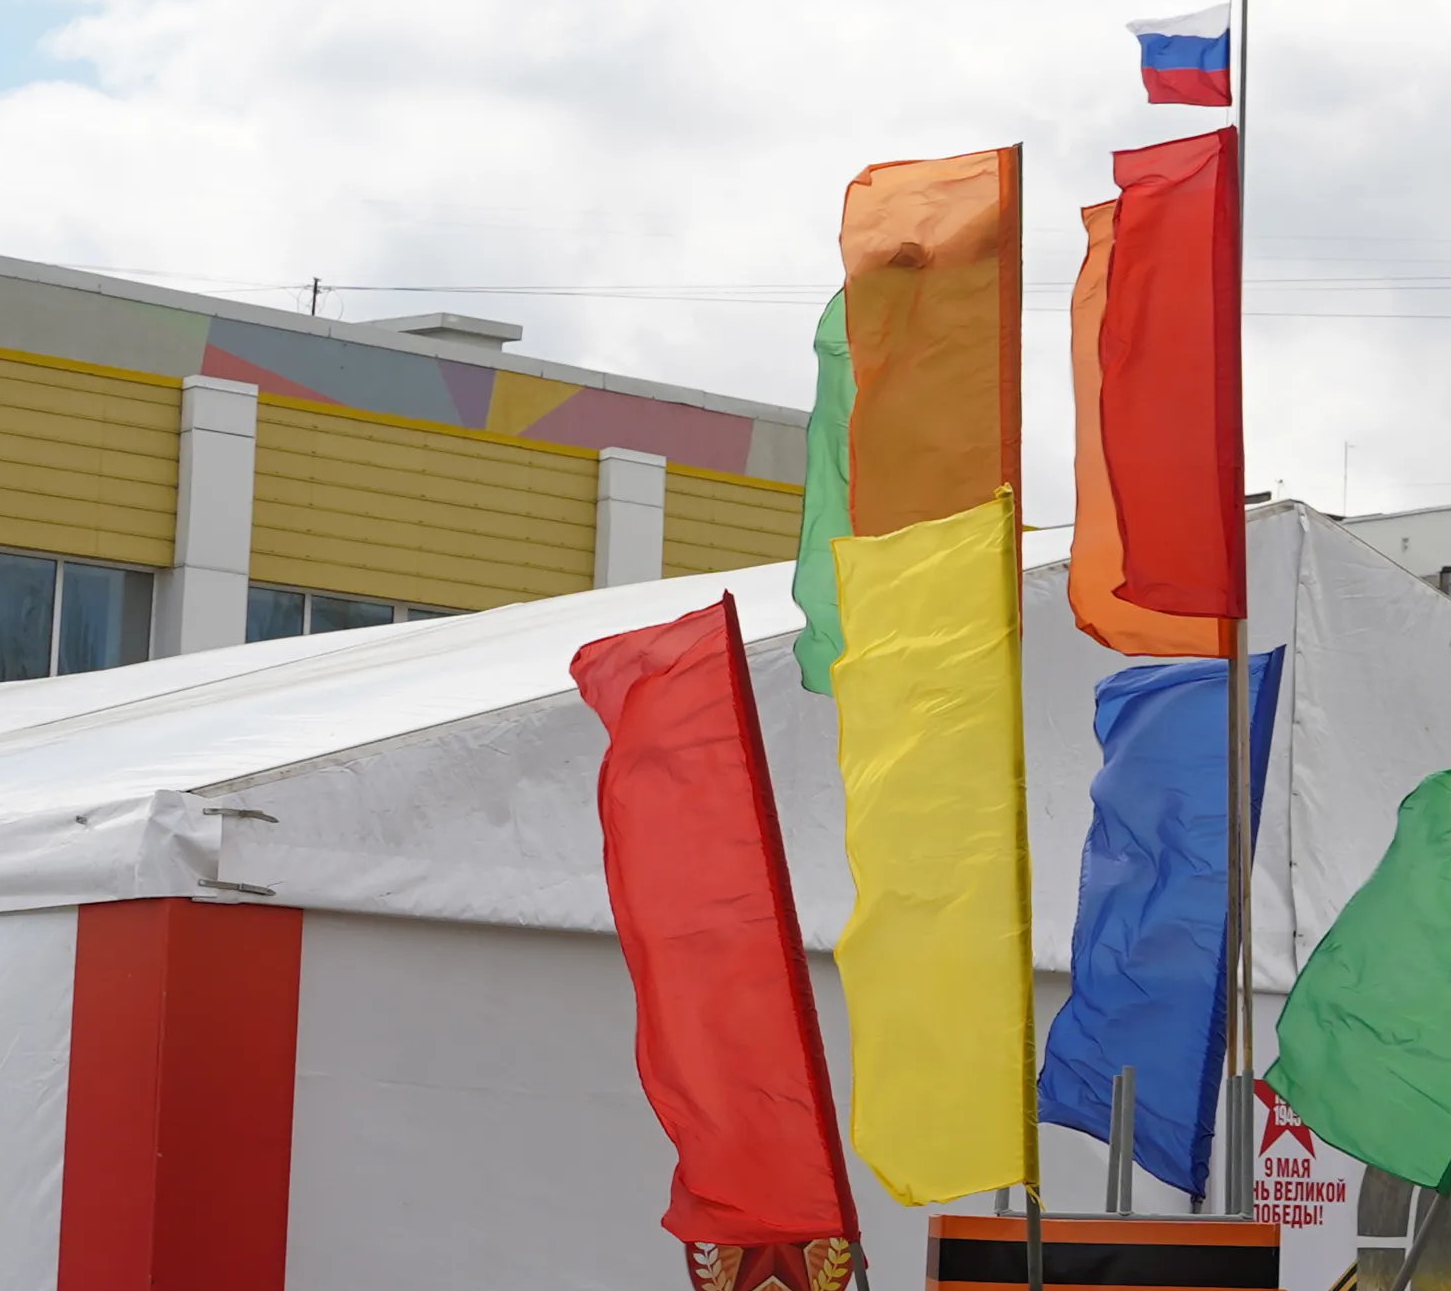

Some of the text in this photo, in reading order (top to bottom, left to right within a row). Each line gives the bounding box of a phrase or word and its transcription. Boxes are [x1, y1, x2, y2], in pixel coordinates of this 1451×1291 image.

[1264, 1157, 1311, 1178] 9 МАЯ
[1274, 1178, 1346, 1203] ВЕЛИКОЙ
